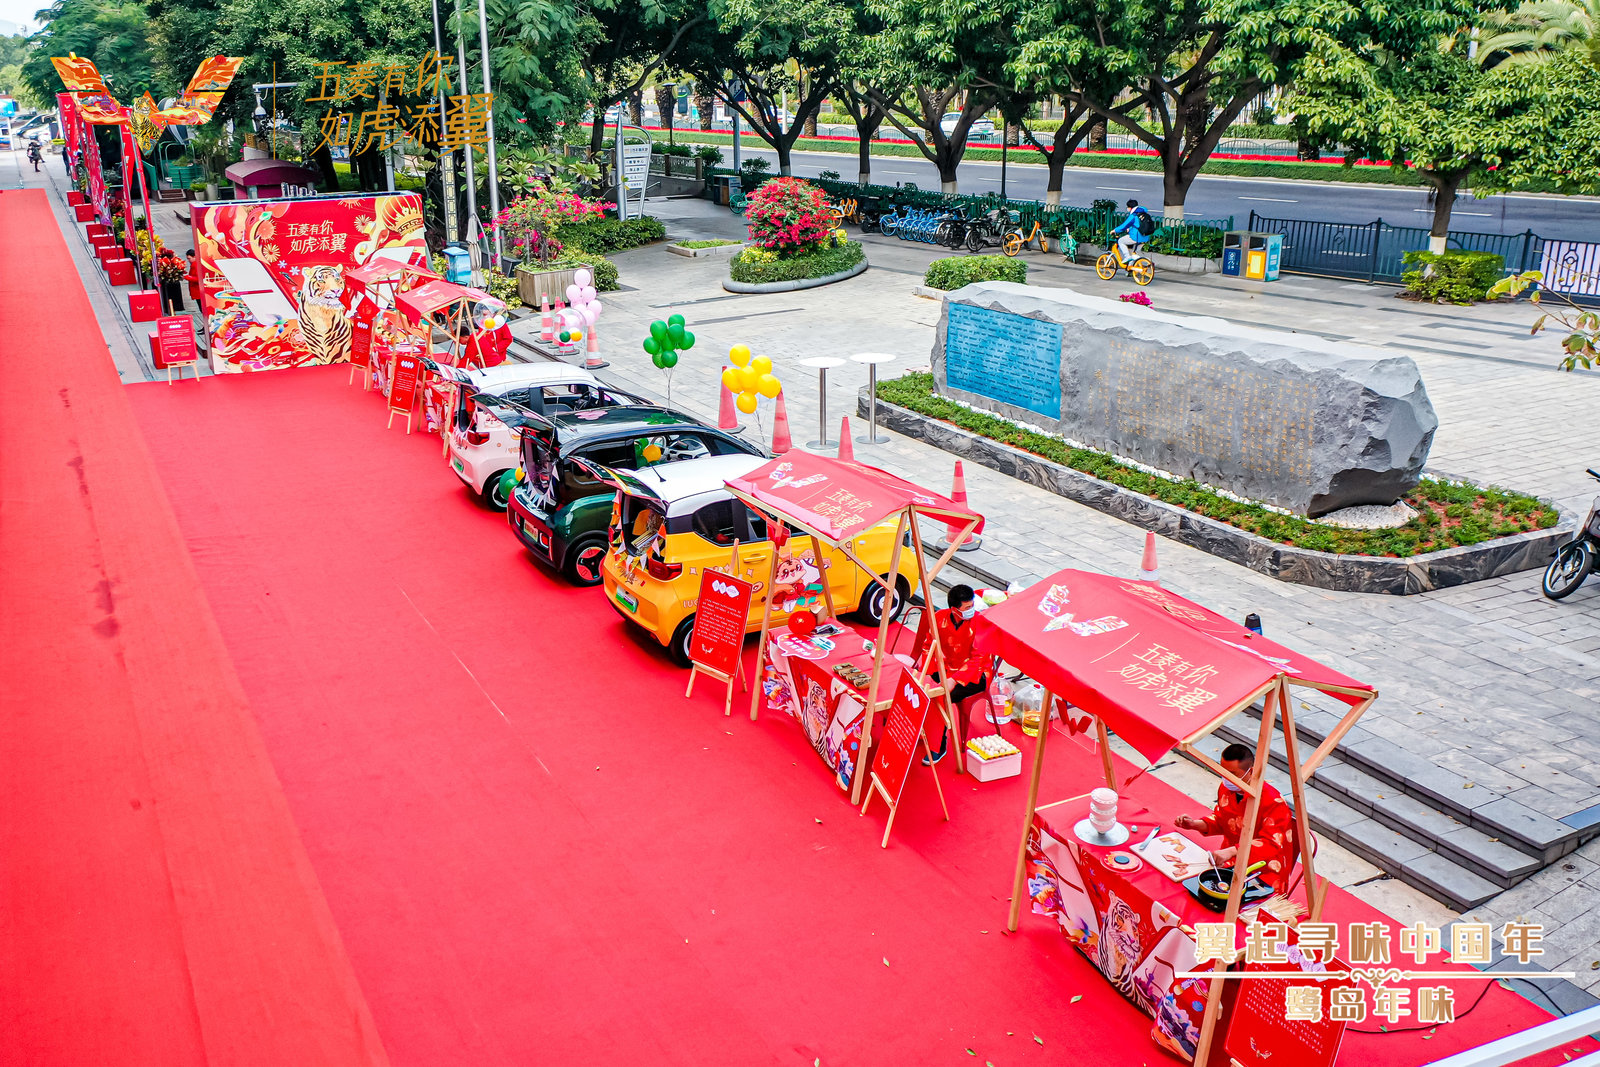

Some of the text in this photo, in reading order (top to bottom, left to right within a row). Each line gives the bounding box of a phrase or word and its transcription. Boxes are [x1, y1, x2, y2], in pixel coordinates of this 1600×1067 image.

[285, 219, 334, 238] 五菱有你
[287, 232, 348, 255] 如虎添翼
[1132, 643, 1219, 686] 五菱有你
[1107, 662, 1218, 716] 如虎添翼
